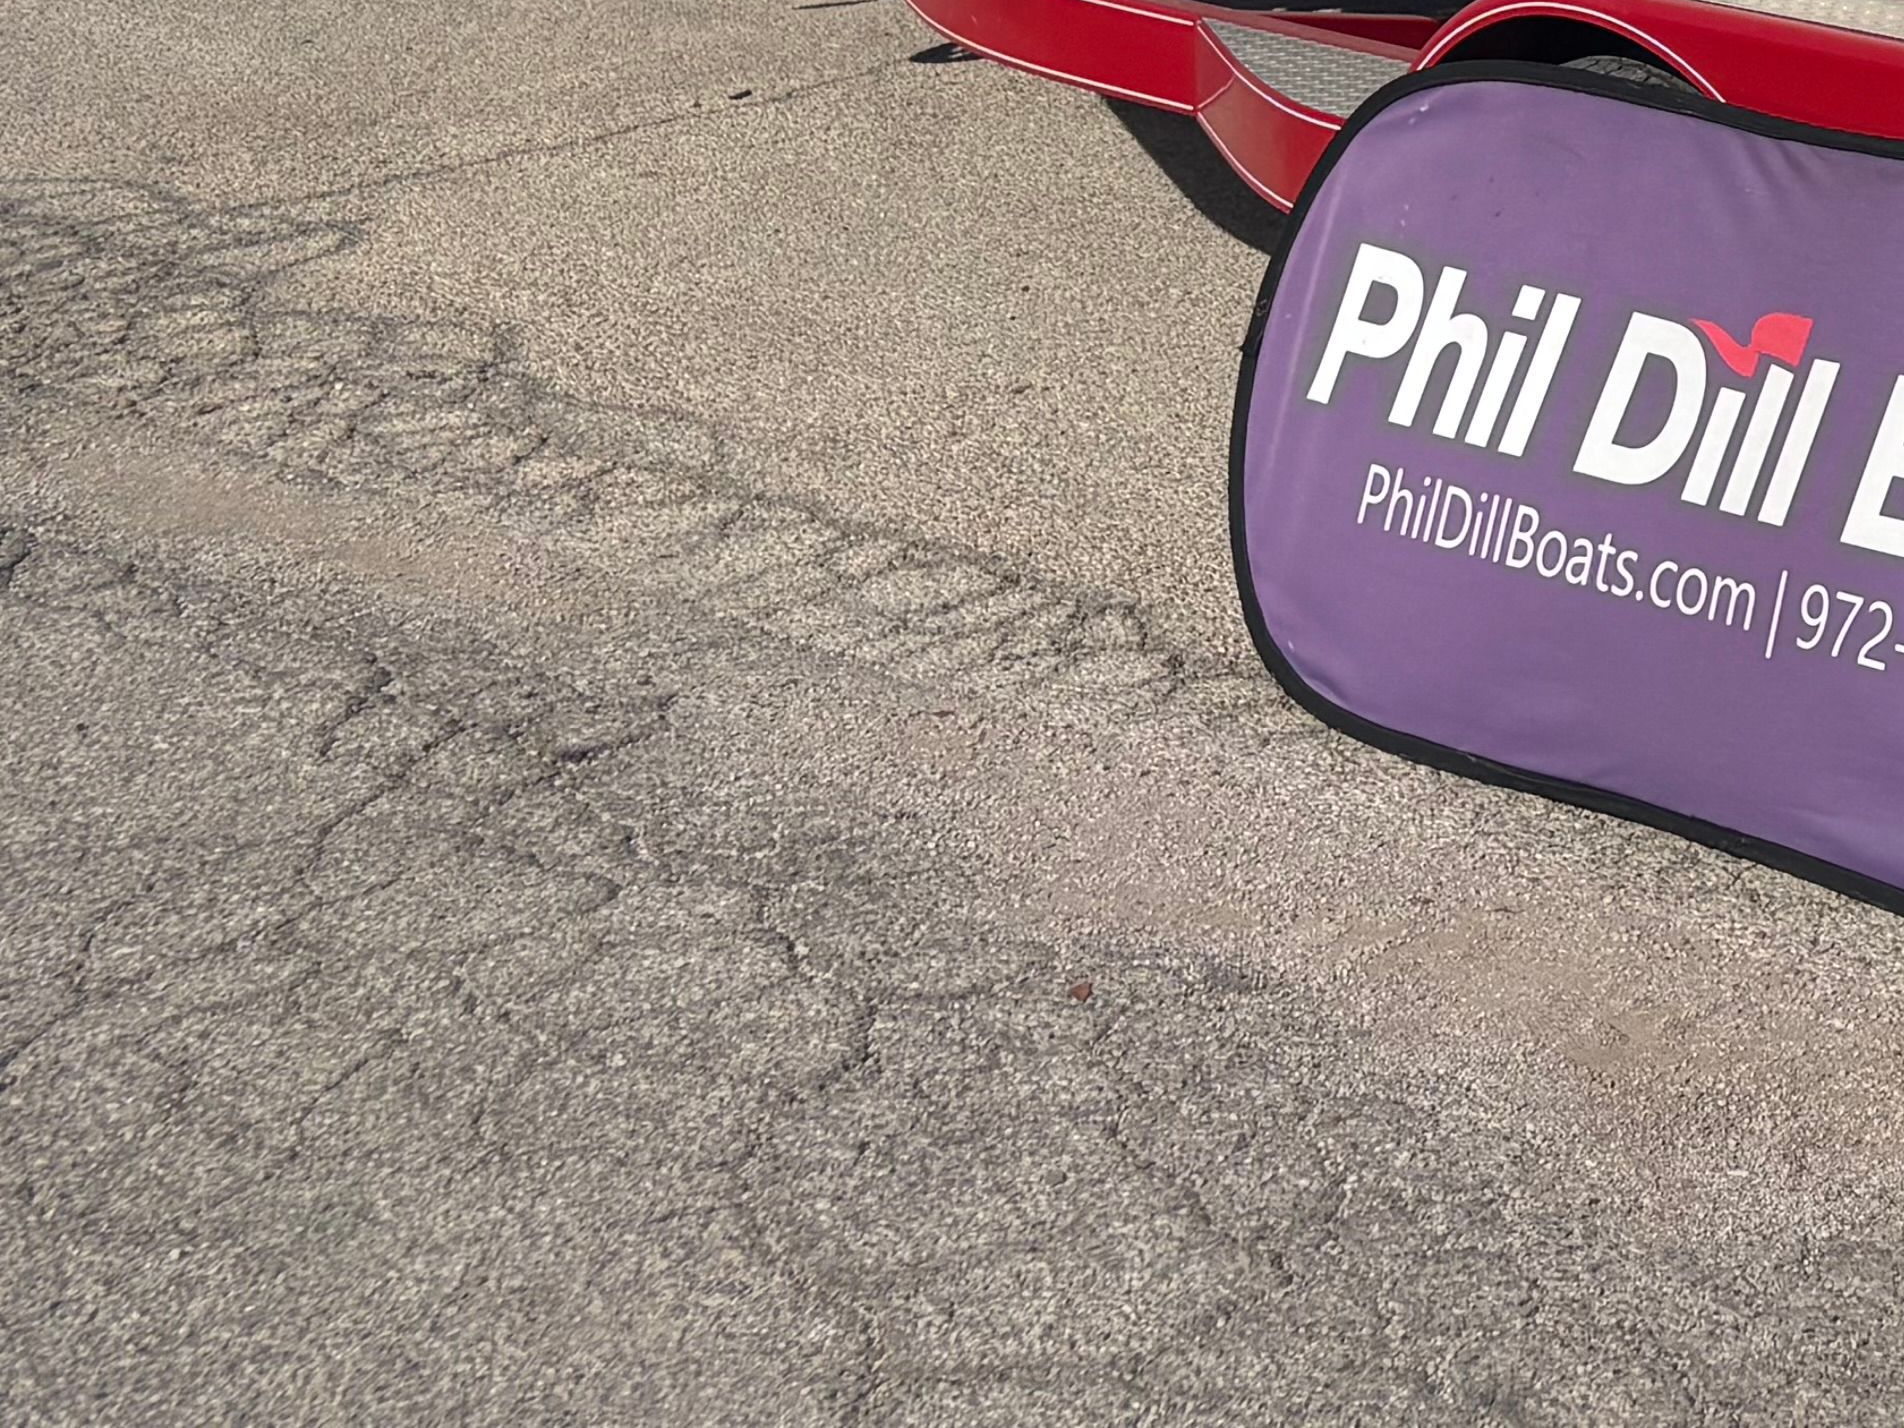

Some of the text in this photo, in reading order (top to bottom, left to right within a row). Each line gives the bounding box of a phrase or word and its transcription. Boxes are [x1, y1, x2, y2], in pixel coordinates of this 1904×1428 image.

[1306, 242, 1583, 458] Phil
[1572, 310, 1841, 528] Dill
[1356, 462, 1757, 632] PhilDillBoats.com
